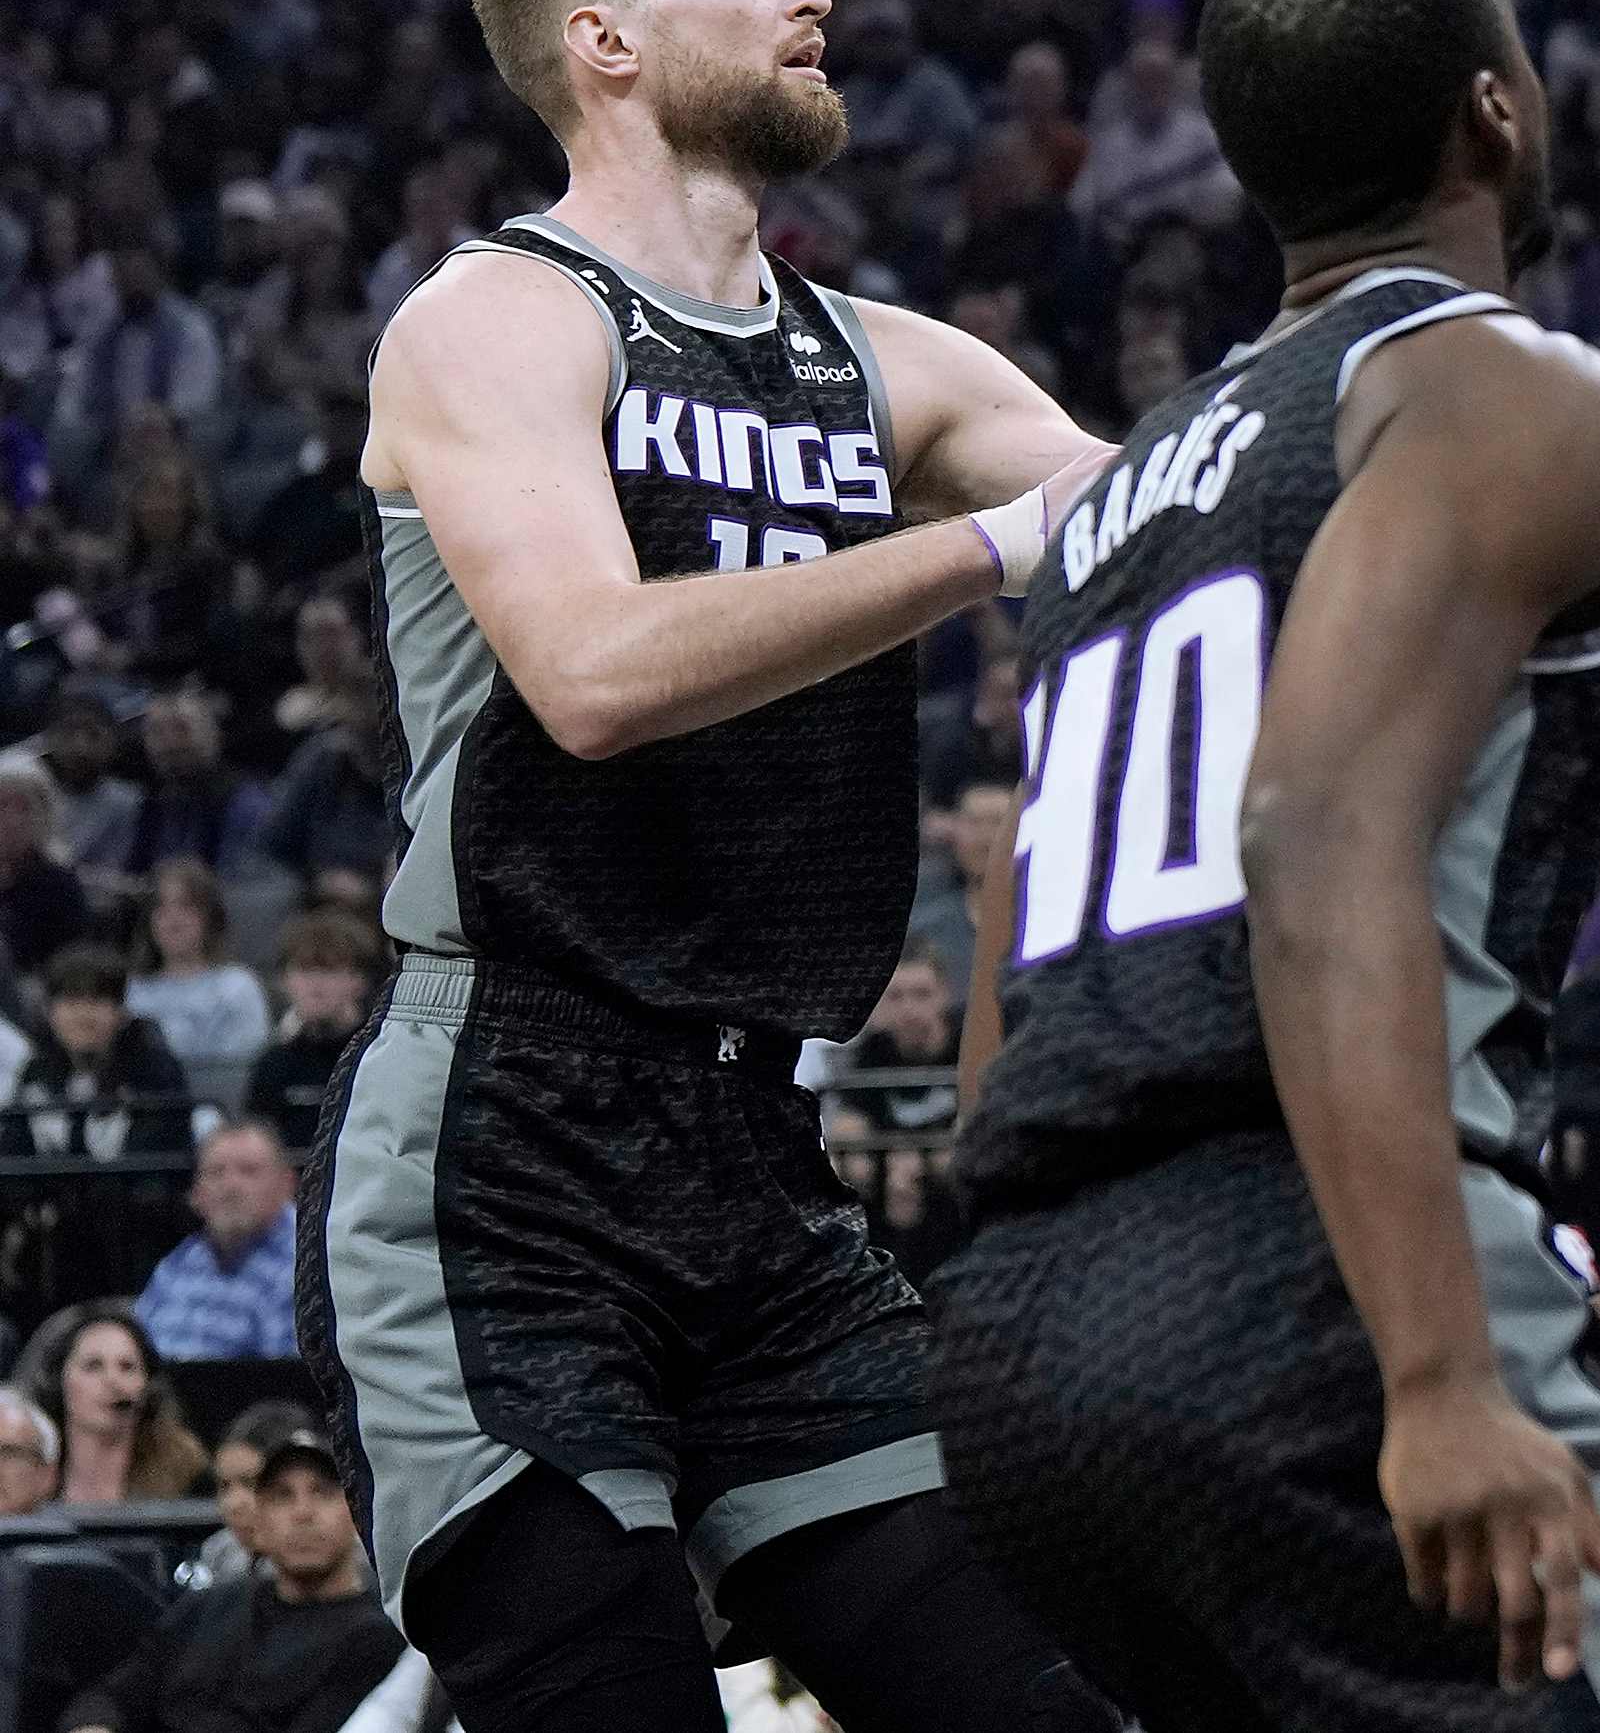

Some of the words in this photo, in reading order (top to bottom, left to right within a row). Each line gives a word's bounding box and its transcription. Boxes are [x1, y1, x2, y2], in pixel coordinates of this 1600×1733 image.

[789, 358, 859, 385] ialpad
[613, 385, 893, 517] KINGS
[1013, 567, 1265, 967] 40
